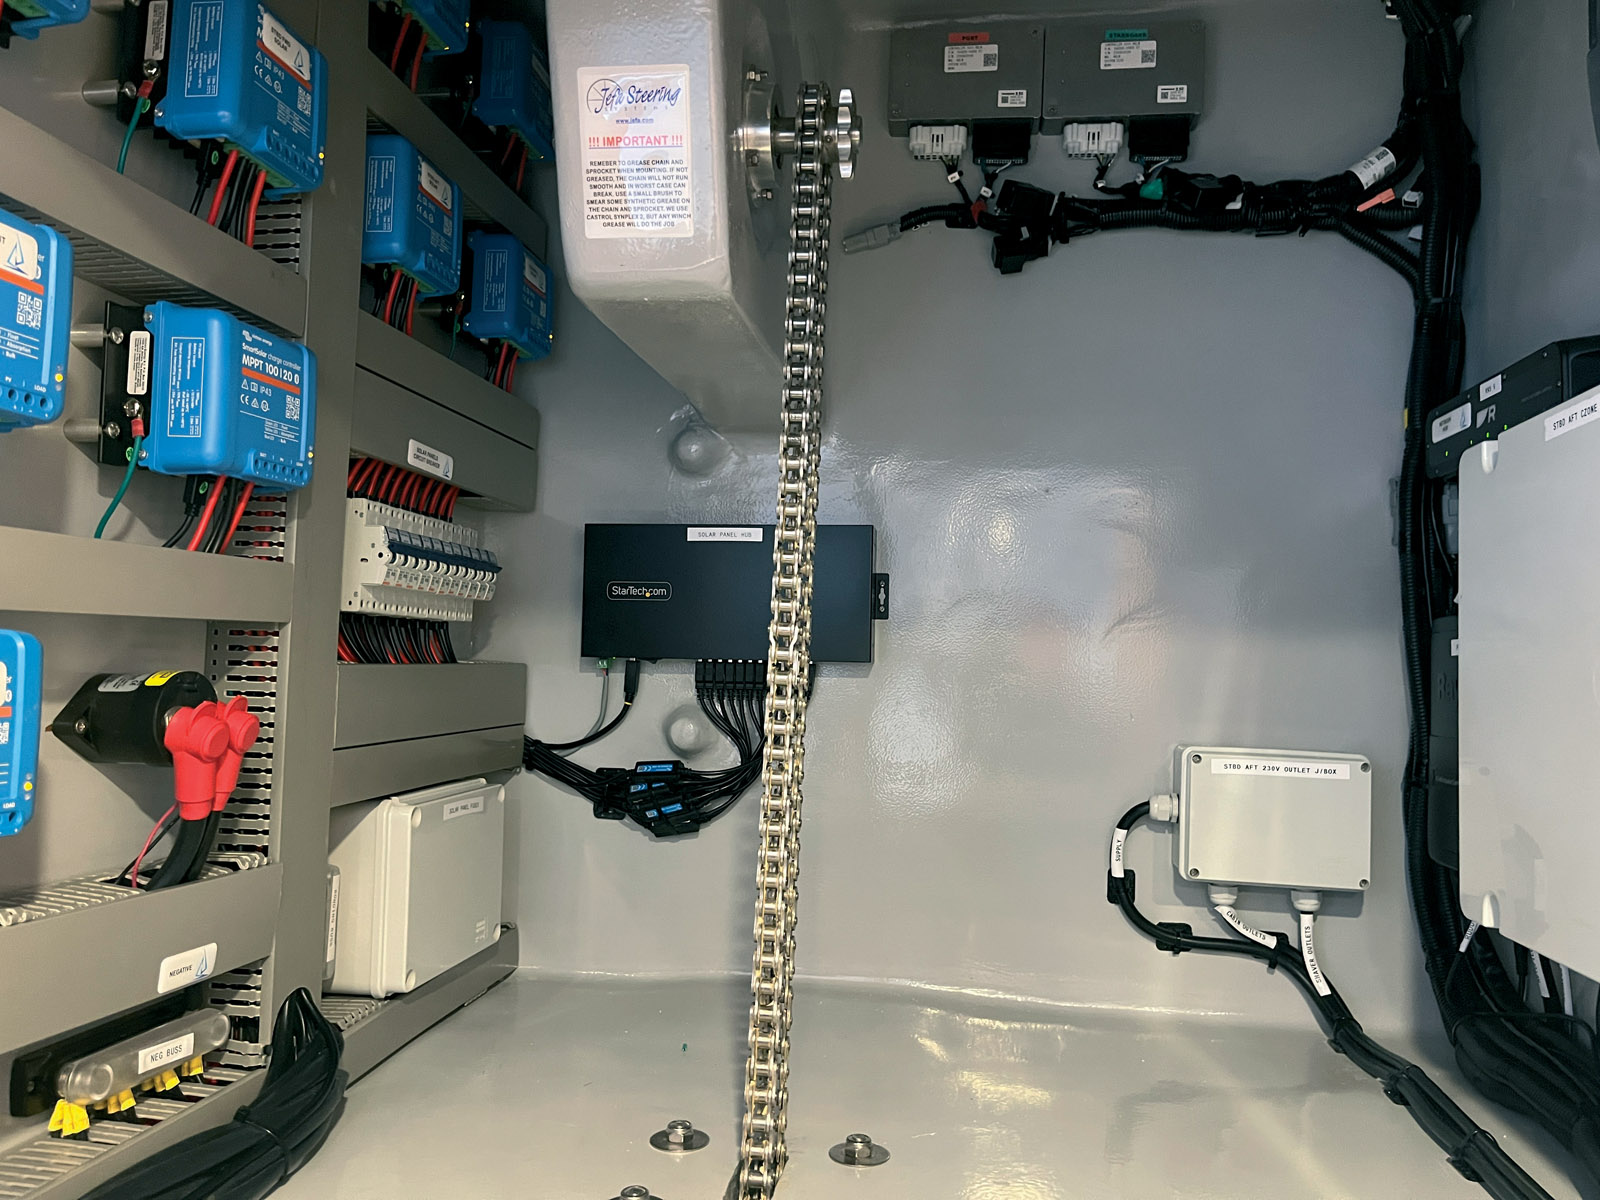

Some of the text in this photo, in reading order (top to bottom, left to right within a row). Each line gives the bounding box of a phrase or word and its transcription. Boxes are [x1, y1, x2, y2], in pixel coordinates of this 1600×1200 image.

[274, 37, 288, 51] SOLAR
[594, 85, 681, 114] Jefa Steering
[589, 135, 683, 147] !!! IMPORTANT !!!
[242, 342, 301, 371] SmartSolar charge controller
[242, 353, 263, 371] MPPT
[34, 384, 47, 393] LOAD
[260, 386, 272, 397] IP43
[1568, 412, 1578, 423] AFT
[1581, 403, 1597, 418] CZONE
[414, 453, 426, 462] CIRCUIT
[417, 447, 439, 461] SOLAR PANELS
[612, 586, 666, 597] StarTech.com
[1227, 911, 1266, 940] CABIN OUTLETS
[1304, 925, 1321, 983] SHAVER OUTLETS
[169, 965, 192, 978] NEGATIVE
[151, 1045, 182, 1063] NEG BUSS
